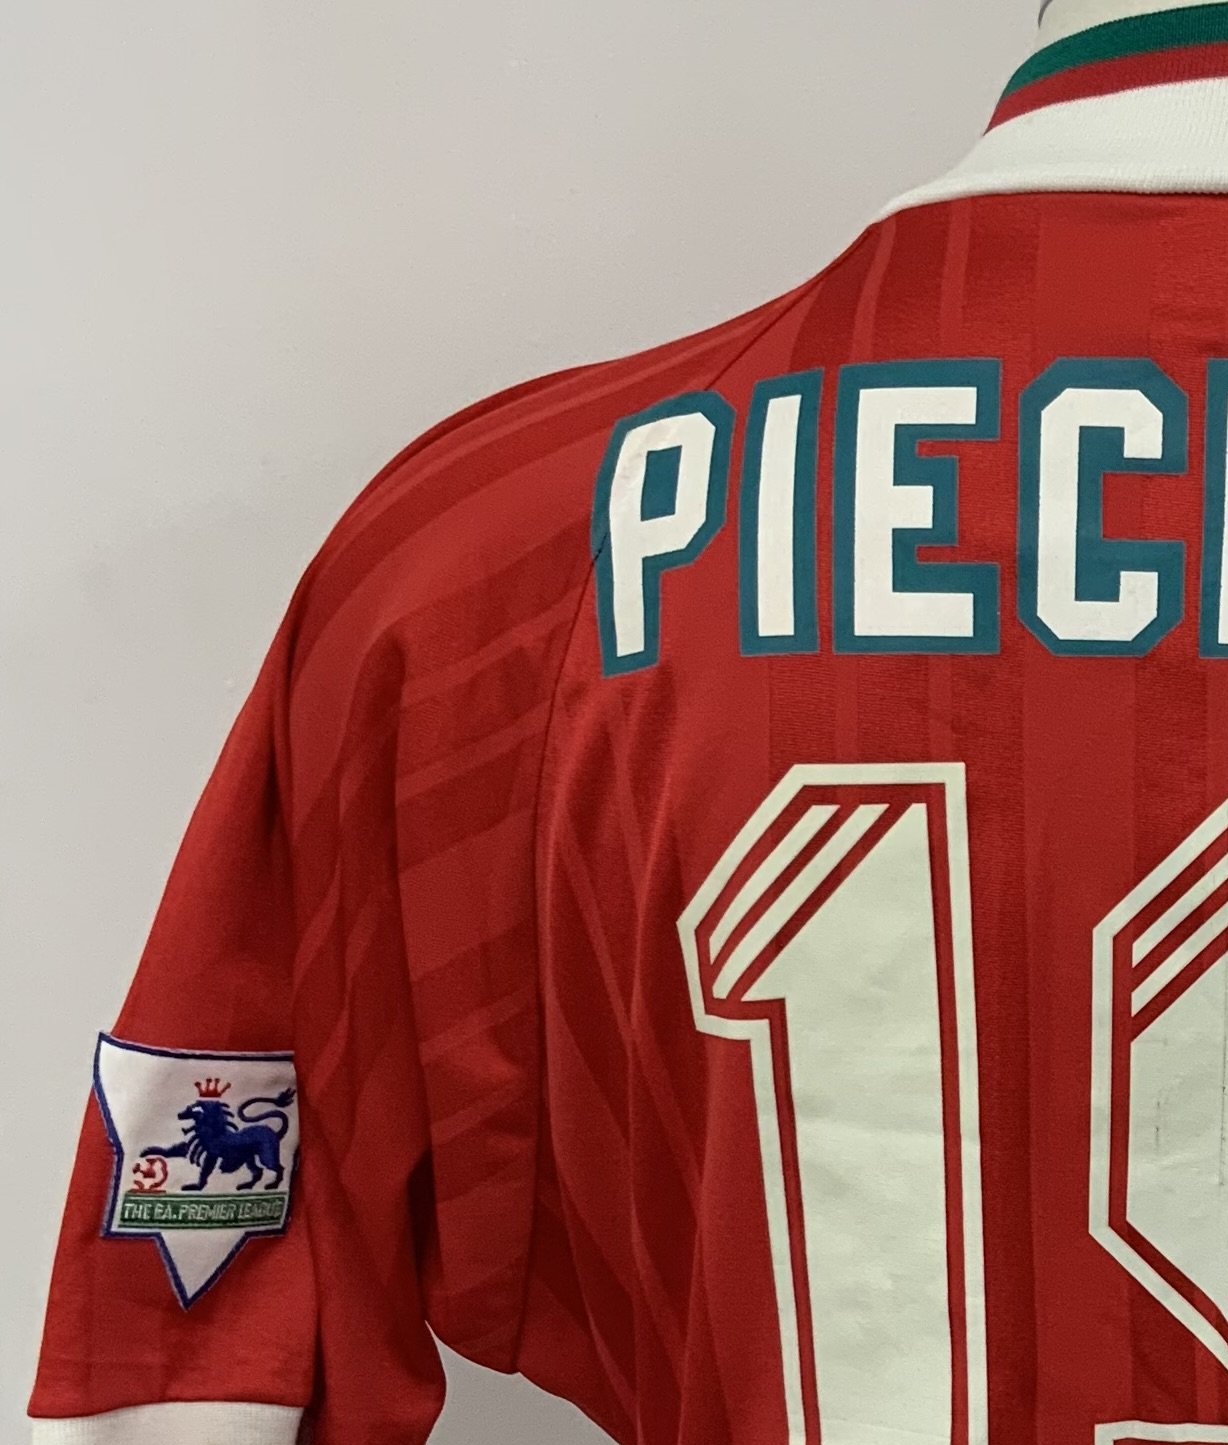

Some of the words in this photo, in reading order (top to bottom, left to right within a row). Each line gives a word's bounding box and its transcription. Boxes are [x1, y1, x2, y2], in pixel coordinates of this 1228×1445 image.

[124, 1202, 152, 1220] THE
[178, 1203, 237, 1220] PREMIER
[238, 1199, 284, 1219] LEAGUE
